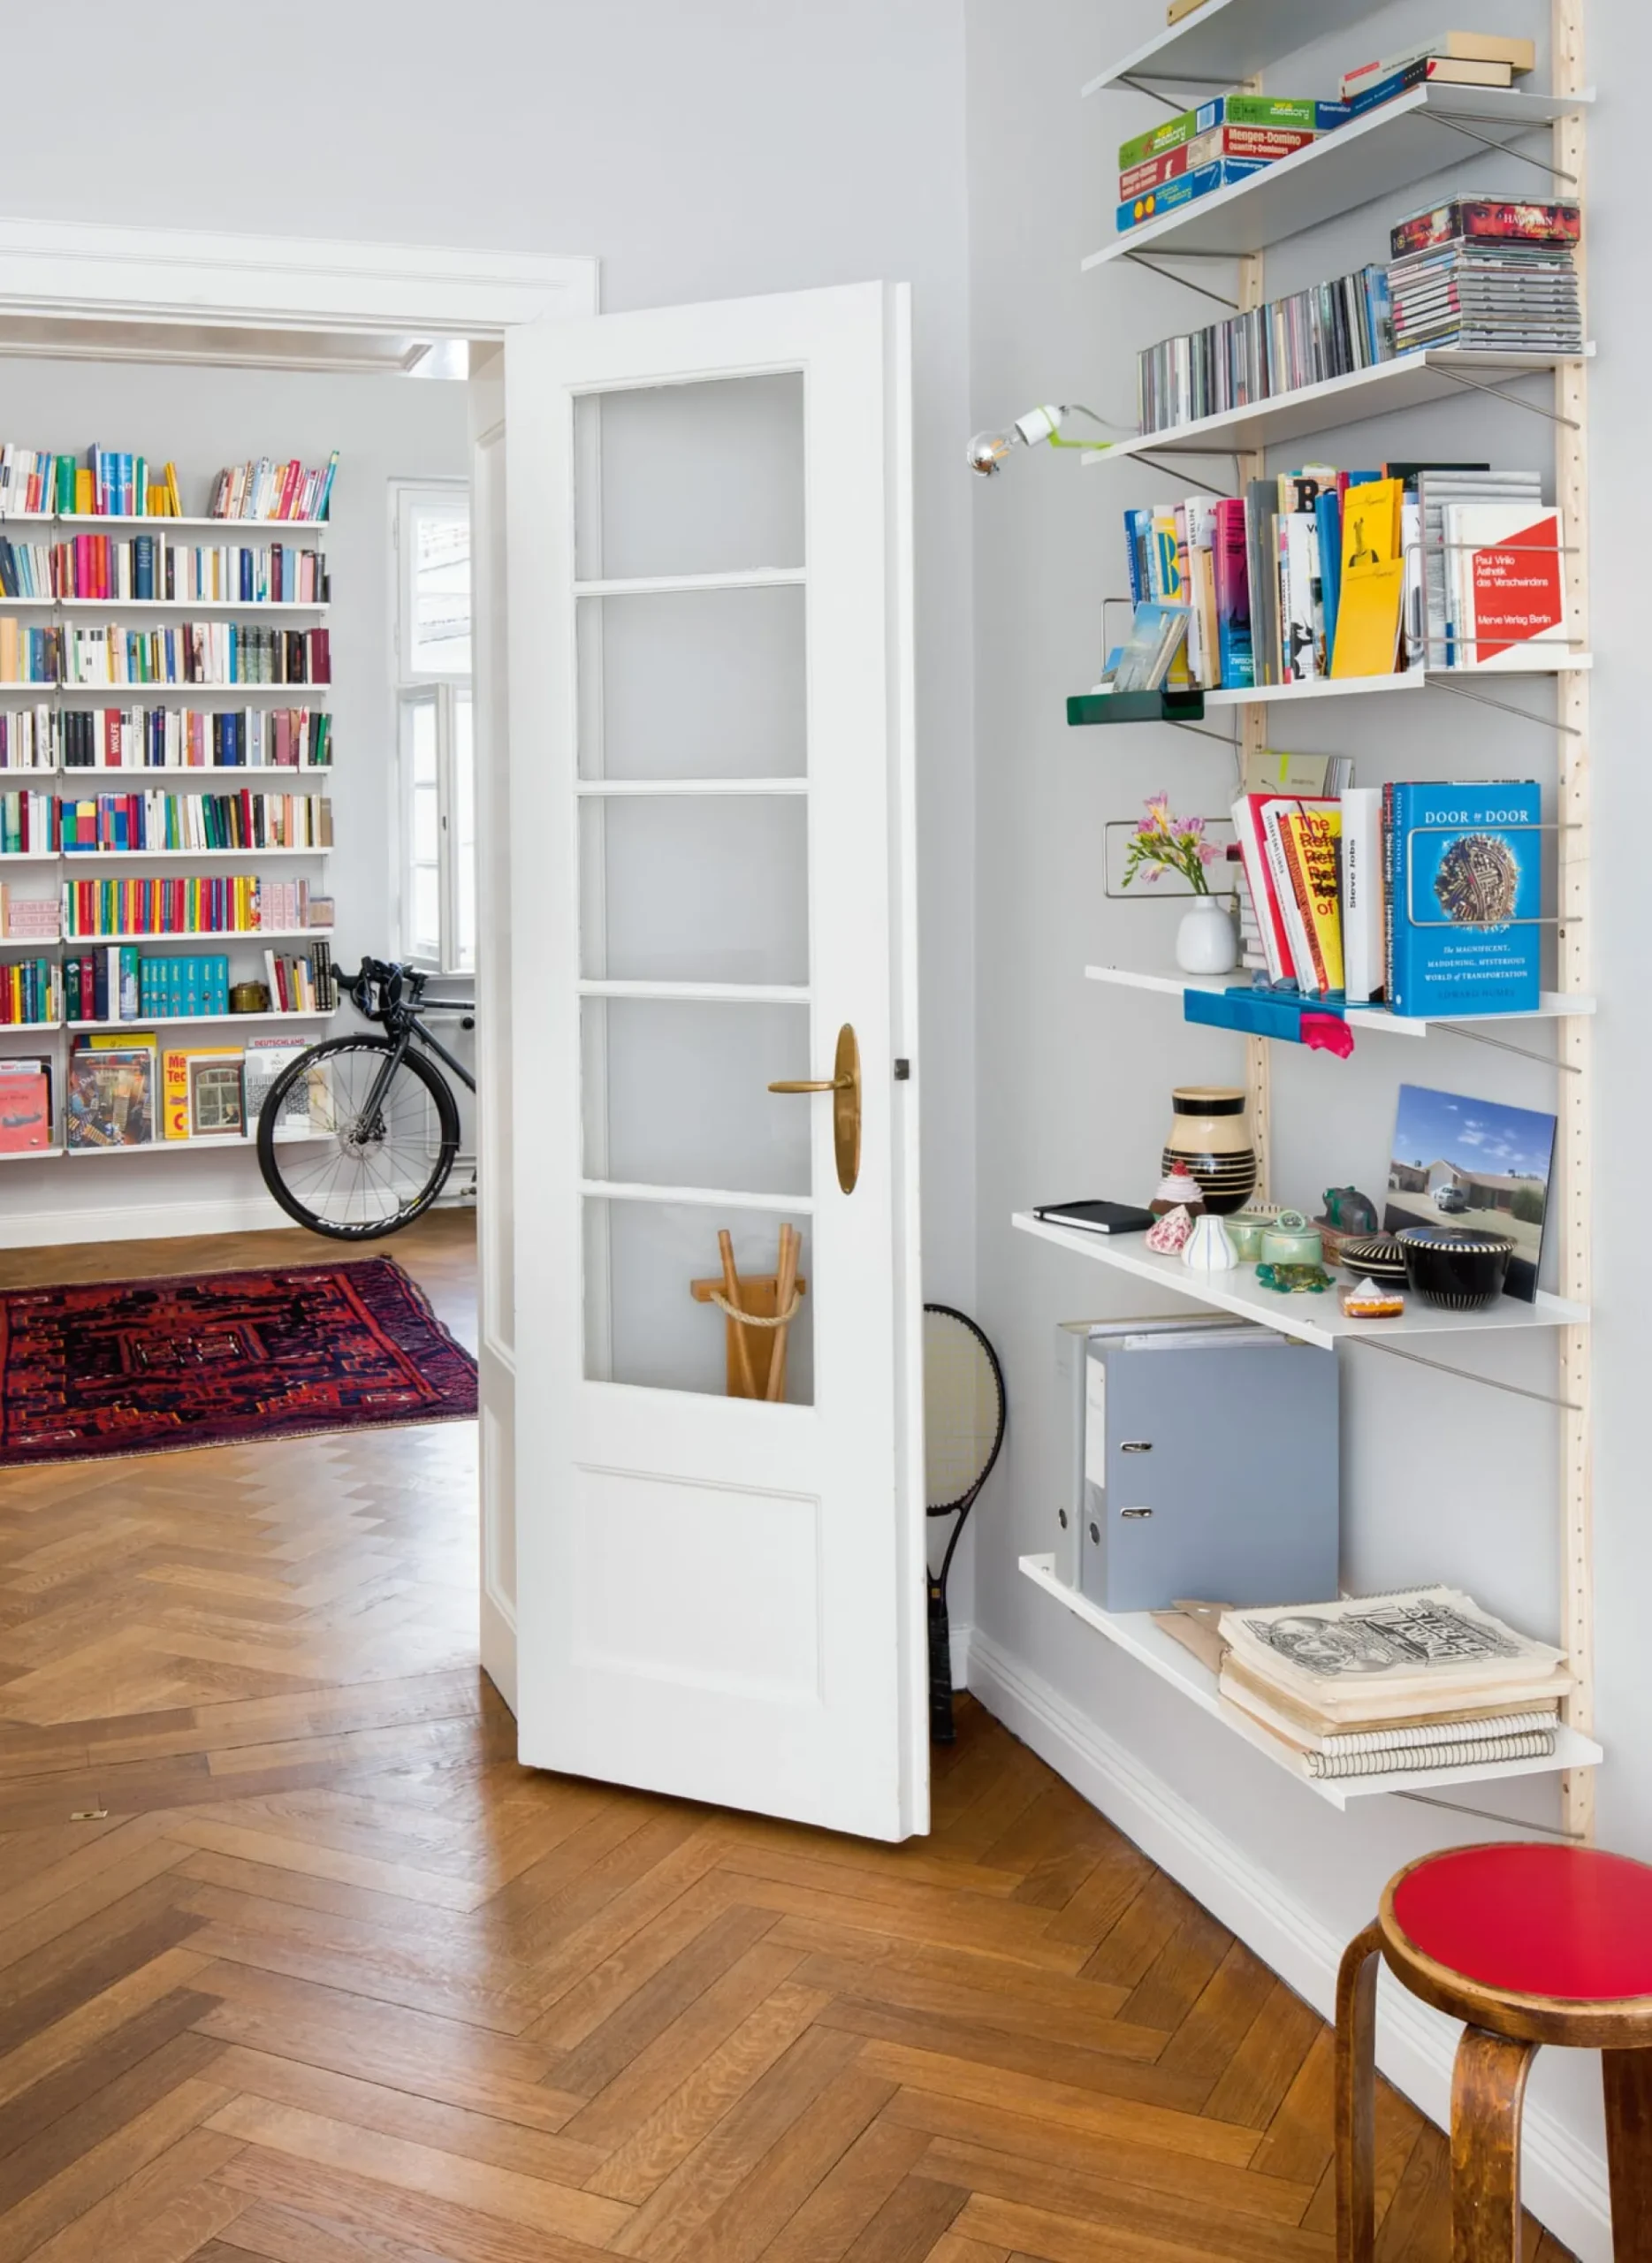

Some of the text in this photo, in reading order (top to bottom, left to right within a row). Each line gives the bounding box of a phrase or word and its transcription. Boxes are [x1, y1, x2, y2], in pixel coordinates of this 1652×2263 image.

[1229, 128, 1301, 146] Mengen-Domino
[1475, 555, 1492, 565] Paul
[1477, 613, 1551, 626] Merve Verlag Berlin
[110, 721, 119, 754] WOLFE
[1295, 815, 1329, 831] The
[1425, 811, 1468, 824] DOOR
[1486, 810, 1528, 822] DOOR
[1317, 899, 1334, 916] of
[1456, 944, 1511, 954] MAGNIFICENT,
[1427, 957, 1526, 968] MADDENING, MYSTERIOUS
[1424, 973, 1452, 982] WORLD
[1462, 971, 1527, 980] TRANSPORTATION
[255, 1038, 305, 1047] DEUTSCHLAND
